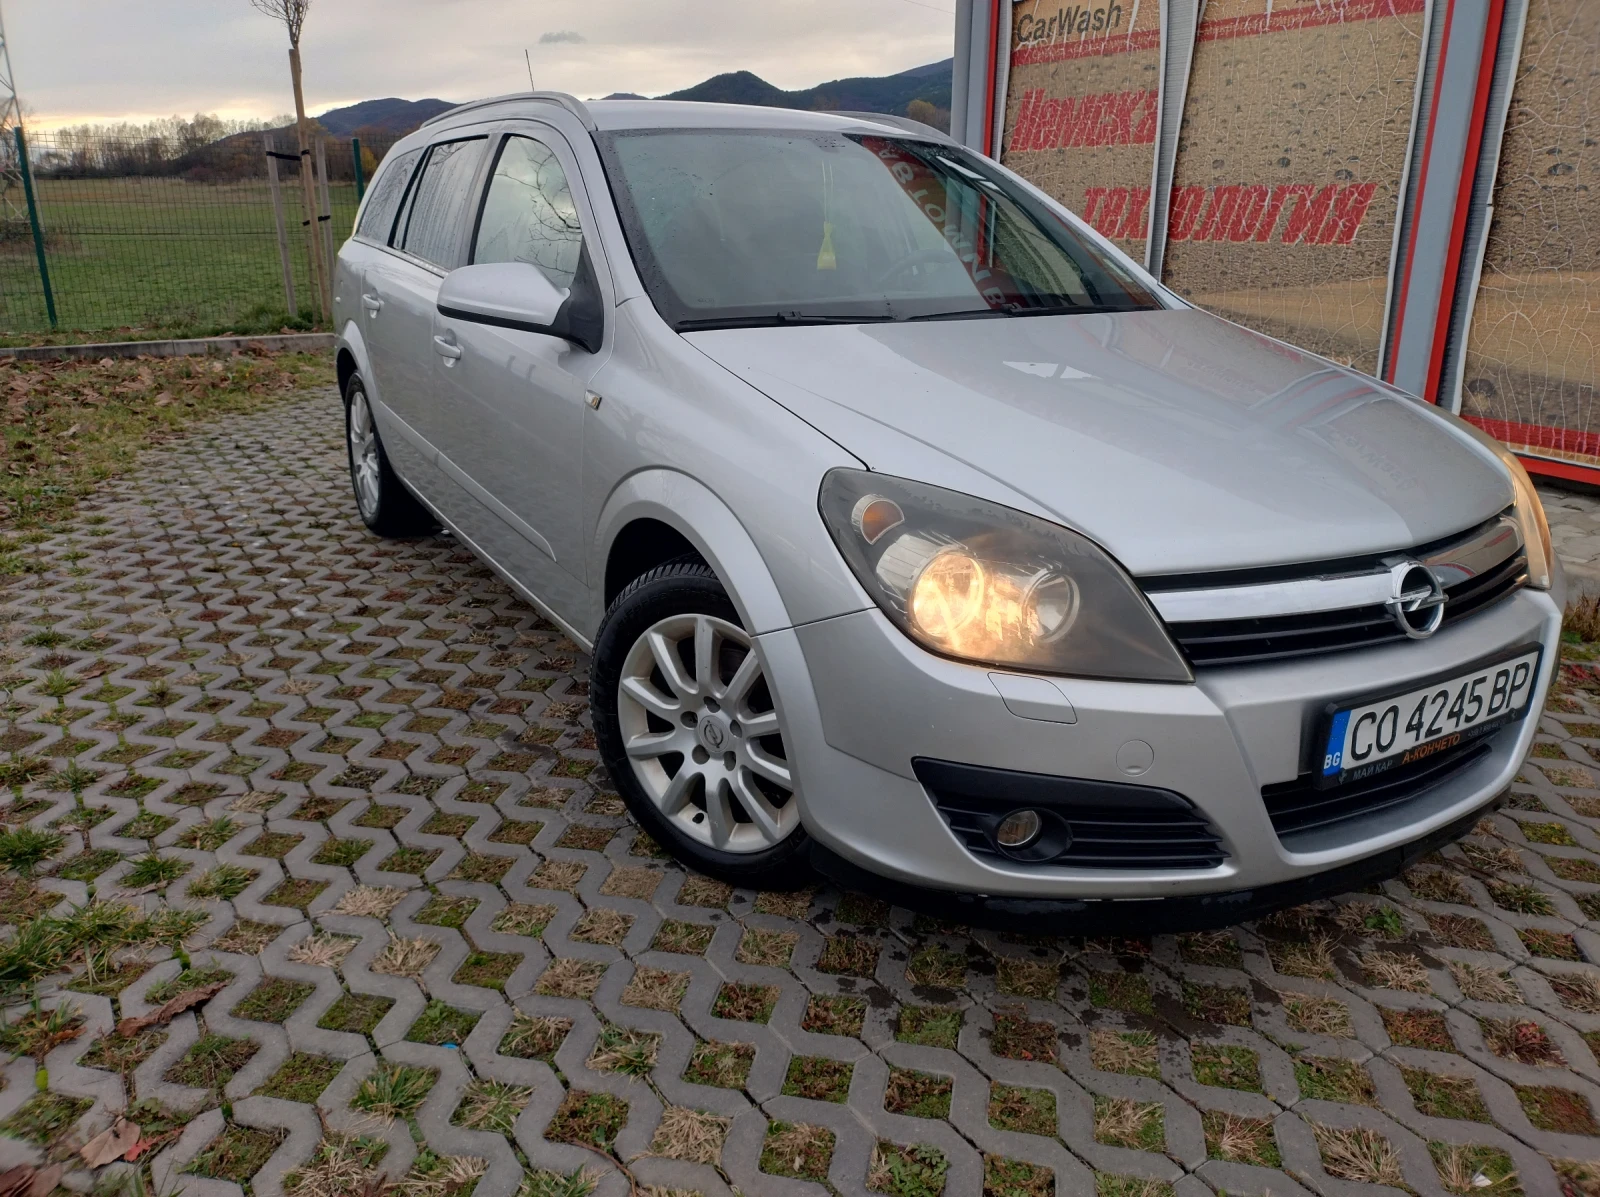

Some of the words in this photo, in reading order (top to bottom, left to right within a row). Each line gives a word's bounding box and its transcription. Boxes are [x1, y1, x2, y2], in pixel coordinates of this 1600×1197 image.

[1016, 0, 1121, 43] CarWash
[1405, 675, 1488, 742] 4245
[1323, 751, 1342, 770] BG
[1352, 765, 1374, 781] МАЙ
[1374, 759, 1393, 775] КАР
[1402, 733, 1461, 765] А-КОНЧЕТО
